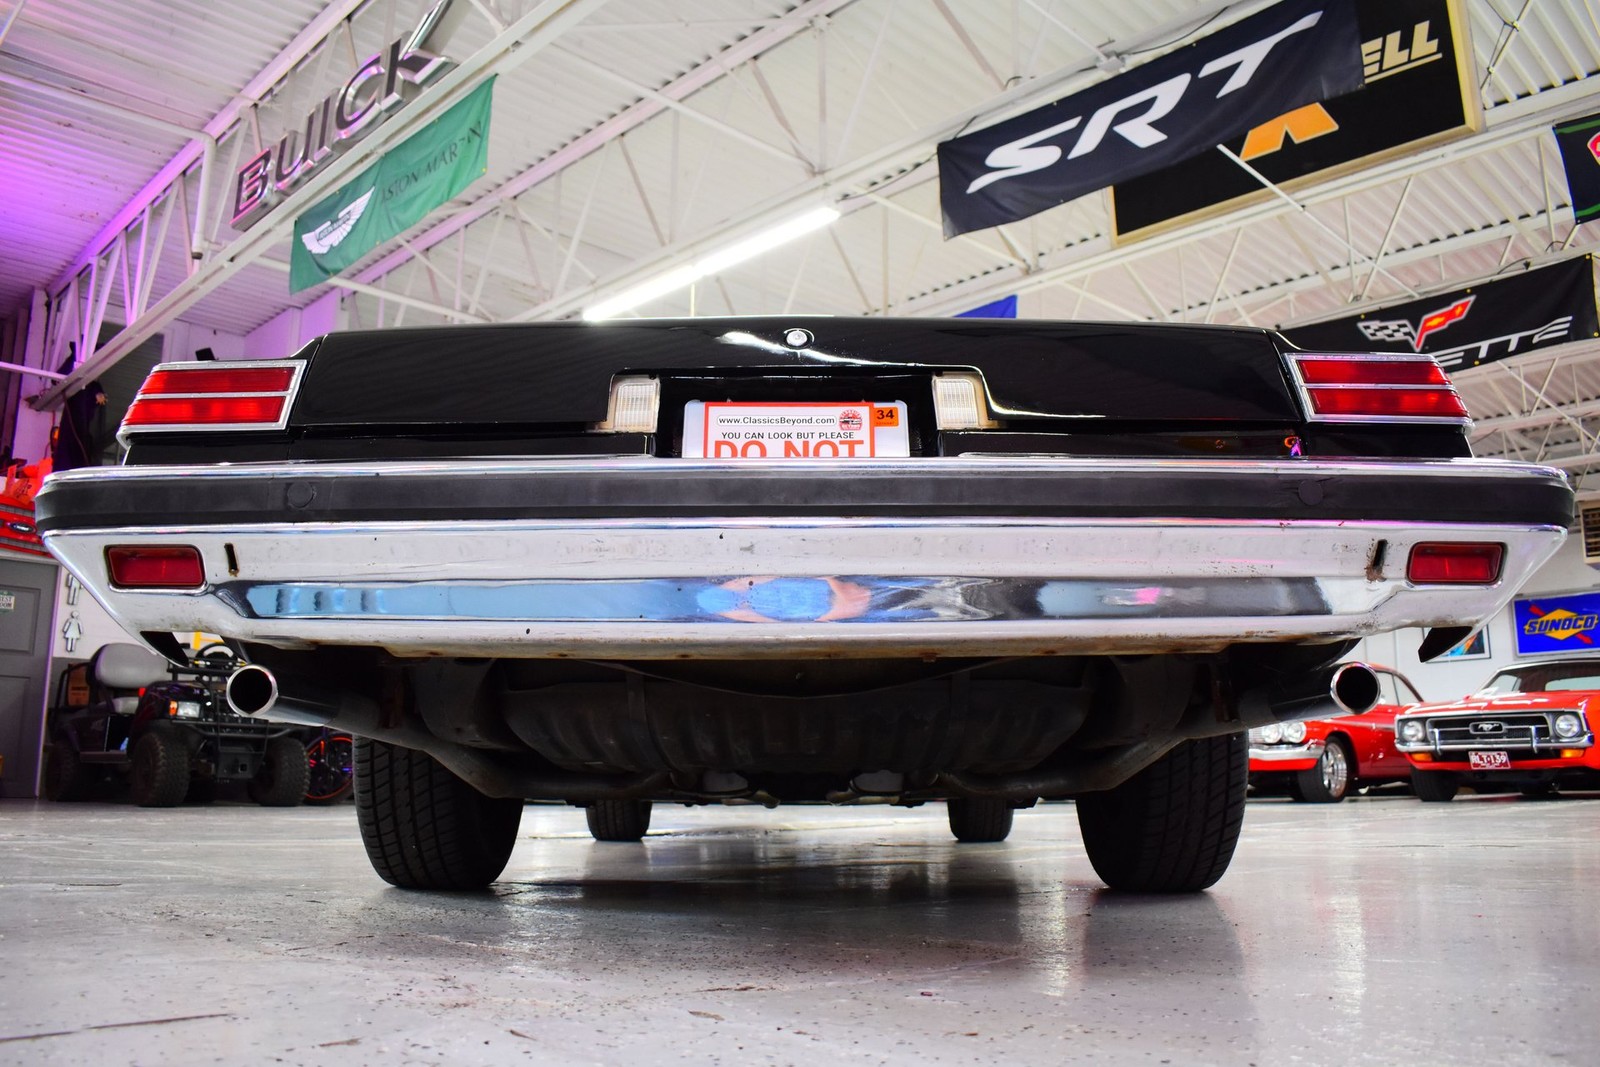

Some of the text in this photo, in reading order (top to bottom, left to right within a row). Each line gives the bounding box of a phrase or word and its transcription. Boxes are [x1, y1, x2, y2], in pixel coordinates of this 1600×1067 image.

[966, 11, 1323, 193] SRT
[229, 0, 452, 228] BUICK
[718, 416, 836, 426] www.ClassicsBeyond.com
[876, 409, 895, 420] 34
[721, 431, 855, 440] YOU CAN LOOK BUT PLEASE
[714, 440, 864, 458] DO NOT
[1525, 614, 1598, 634] SUNOCO
